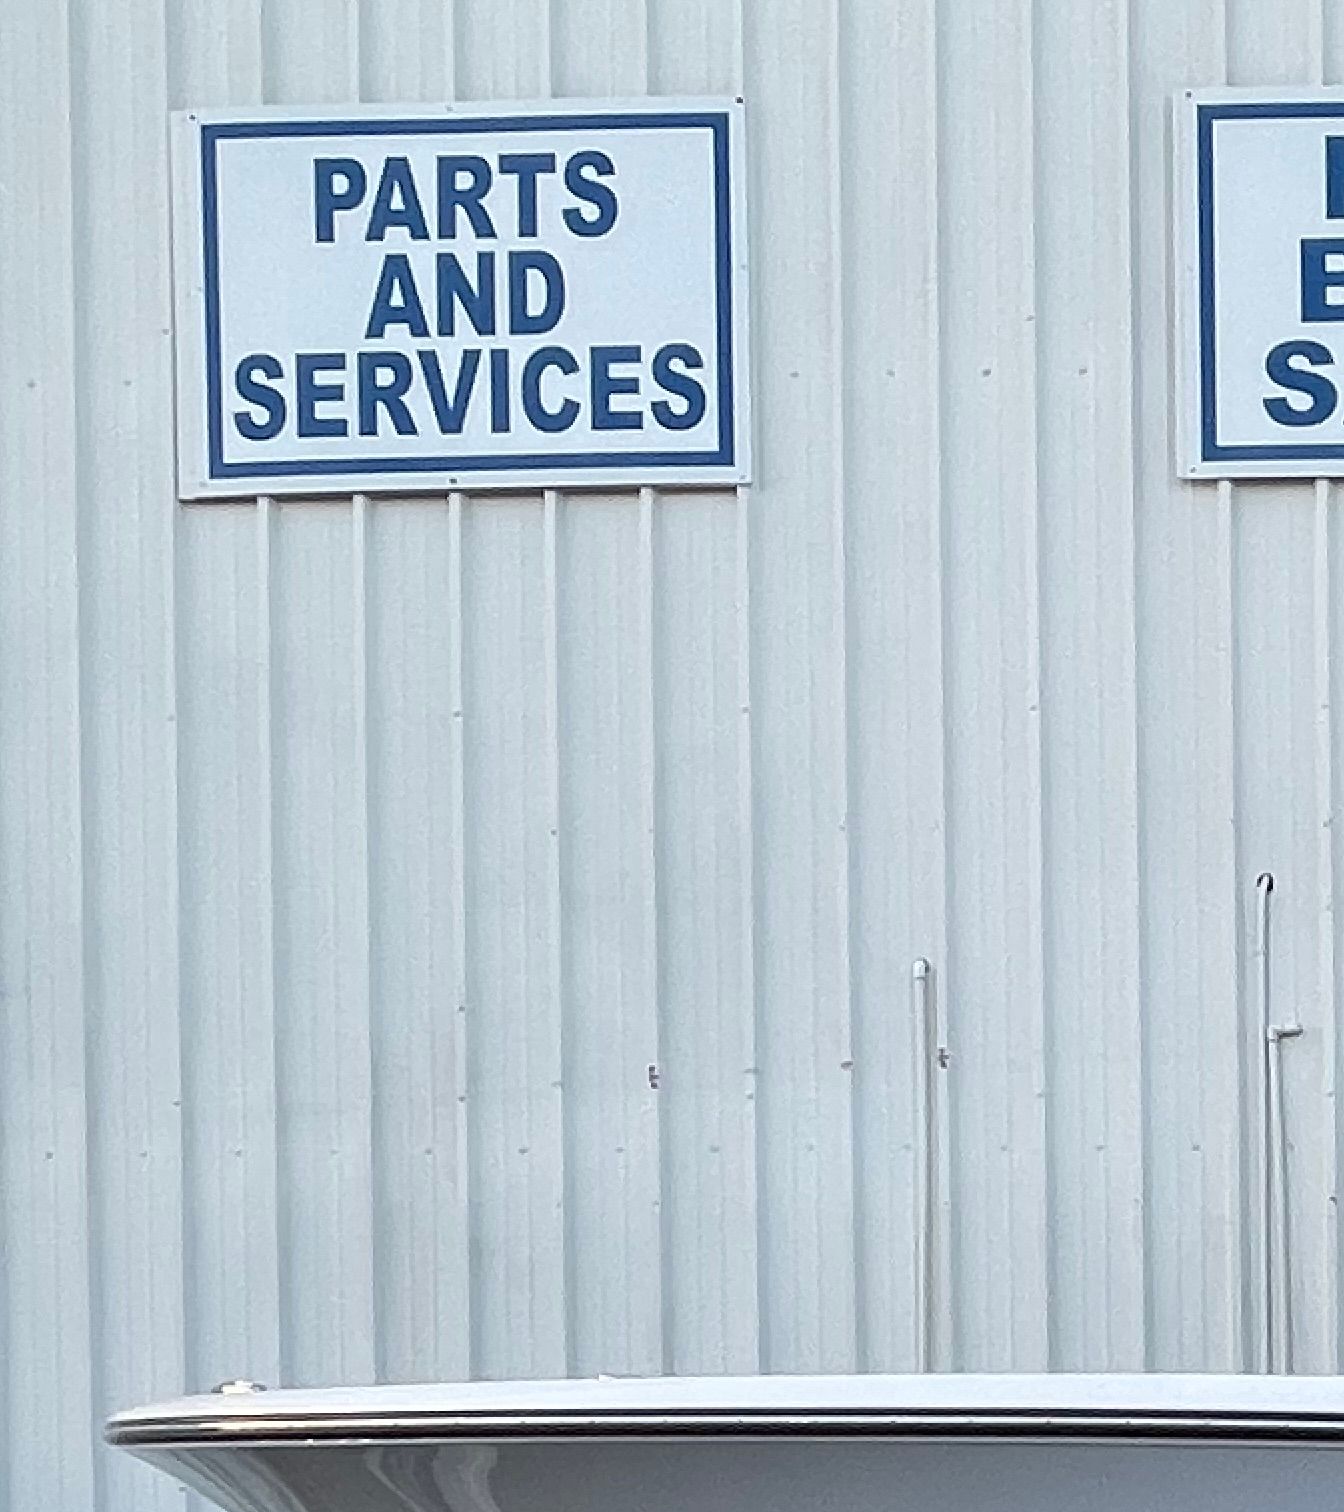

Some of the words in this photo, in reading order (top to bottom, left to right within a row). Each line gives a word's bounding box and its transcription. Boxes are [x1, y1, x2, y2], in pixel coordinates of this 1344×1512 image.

[313, 151, 618, 243] PARTS
[364, 250, 566, 339] AND
[233, 343, 706, 441] SERVICES
